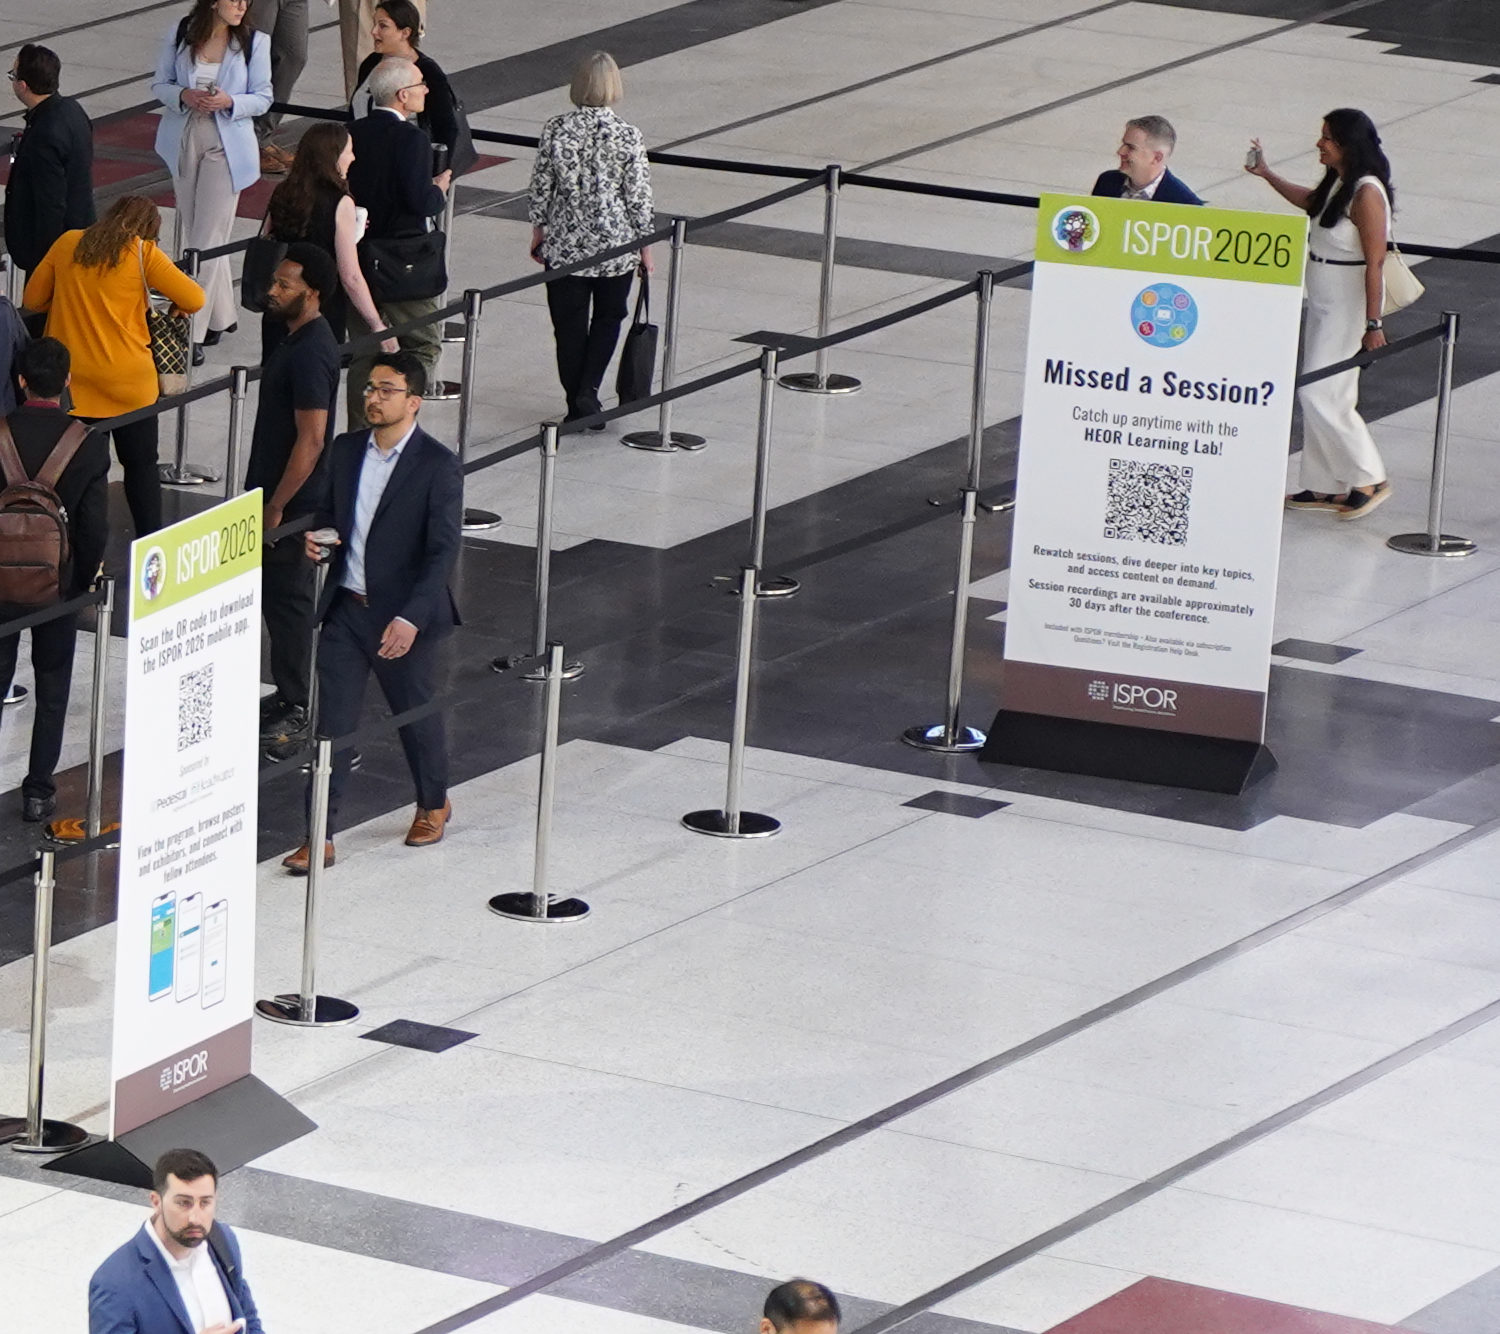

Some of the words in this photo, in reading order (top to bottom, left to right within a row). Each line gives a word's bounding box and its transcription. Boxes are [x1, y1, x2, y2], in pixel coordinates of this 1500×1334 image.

[1044, 359, 1130, 391] Missed
[1139, 376, 1152, 394] a
[1163, 371, 1275, 406] Session?
[1072, 406, 1108, 424] Catch
[1113, 414, 1128, 428] up
[1132, 415, 1182, 432] anytime
[1187, 419, 1214, 435] with
[1218, 422, 1238, 437] the
[1084, 428, 1122, 445] HEOR
[1128, 432, 1189, 455] Learning
[1194, 439, 1223, 456] Lab!
[1033, 545, 1073, 559] Rewatch
[1122, 555, 1141, 567] dive
[1145, 558, 1177, 573] deeper
[1180, 562, 1200, 574] into
[1202, 565, 1219, 578] key
[1067, 563, 1085, 574] and
[1088, 567, 1120, 579] access
[1123, 571, 1159, 583] content
[1163, 576, 1173, 585] on
[1177, 576, 1217, 590] demand.
[1029, 579, 1064, 592] Session
[1067, 584, 1118, 600] recordings
[1121, 591, 1136, 601] are
[1139, 592, 1182, 607] available
[1186, 599, 1255, 617] approximately
[1069, 598, 1081, 608] 30
[1085, 599, 1106, 612] days
[1109, 603, 1132, 615] after
[1136, 606, 1151, 617] the
[1154, 609, 1210, 624] conference.
[140, 635, 158, 654] Scan
[161, 627, 173, 644] the
[177, 619, 187, 639] QR
[190, 611, 207, 632] code
[210, 608, 217, 623] to
[220, 588, 254, 619] download
[143, 657, 156, 674] the
[159, 642, 182, 667] ISPOR
[186, 633, 204, 657] 2026
[207, 622, 232, 646] mobile
[235, 617, 250, 635] app.
[1113, 683, 1177, 710] ISPOR
[172, 1050, 208, 1086] ISPOR
